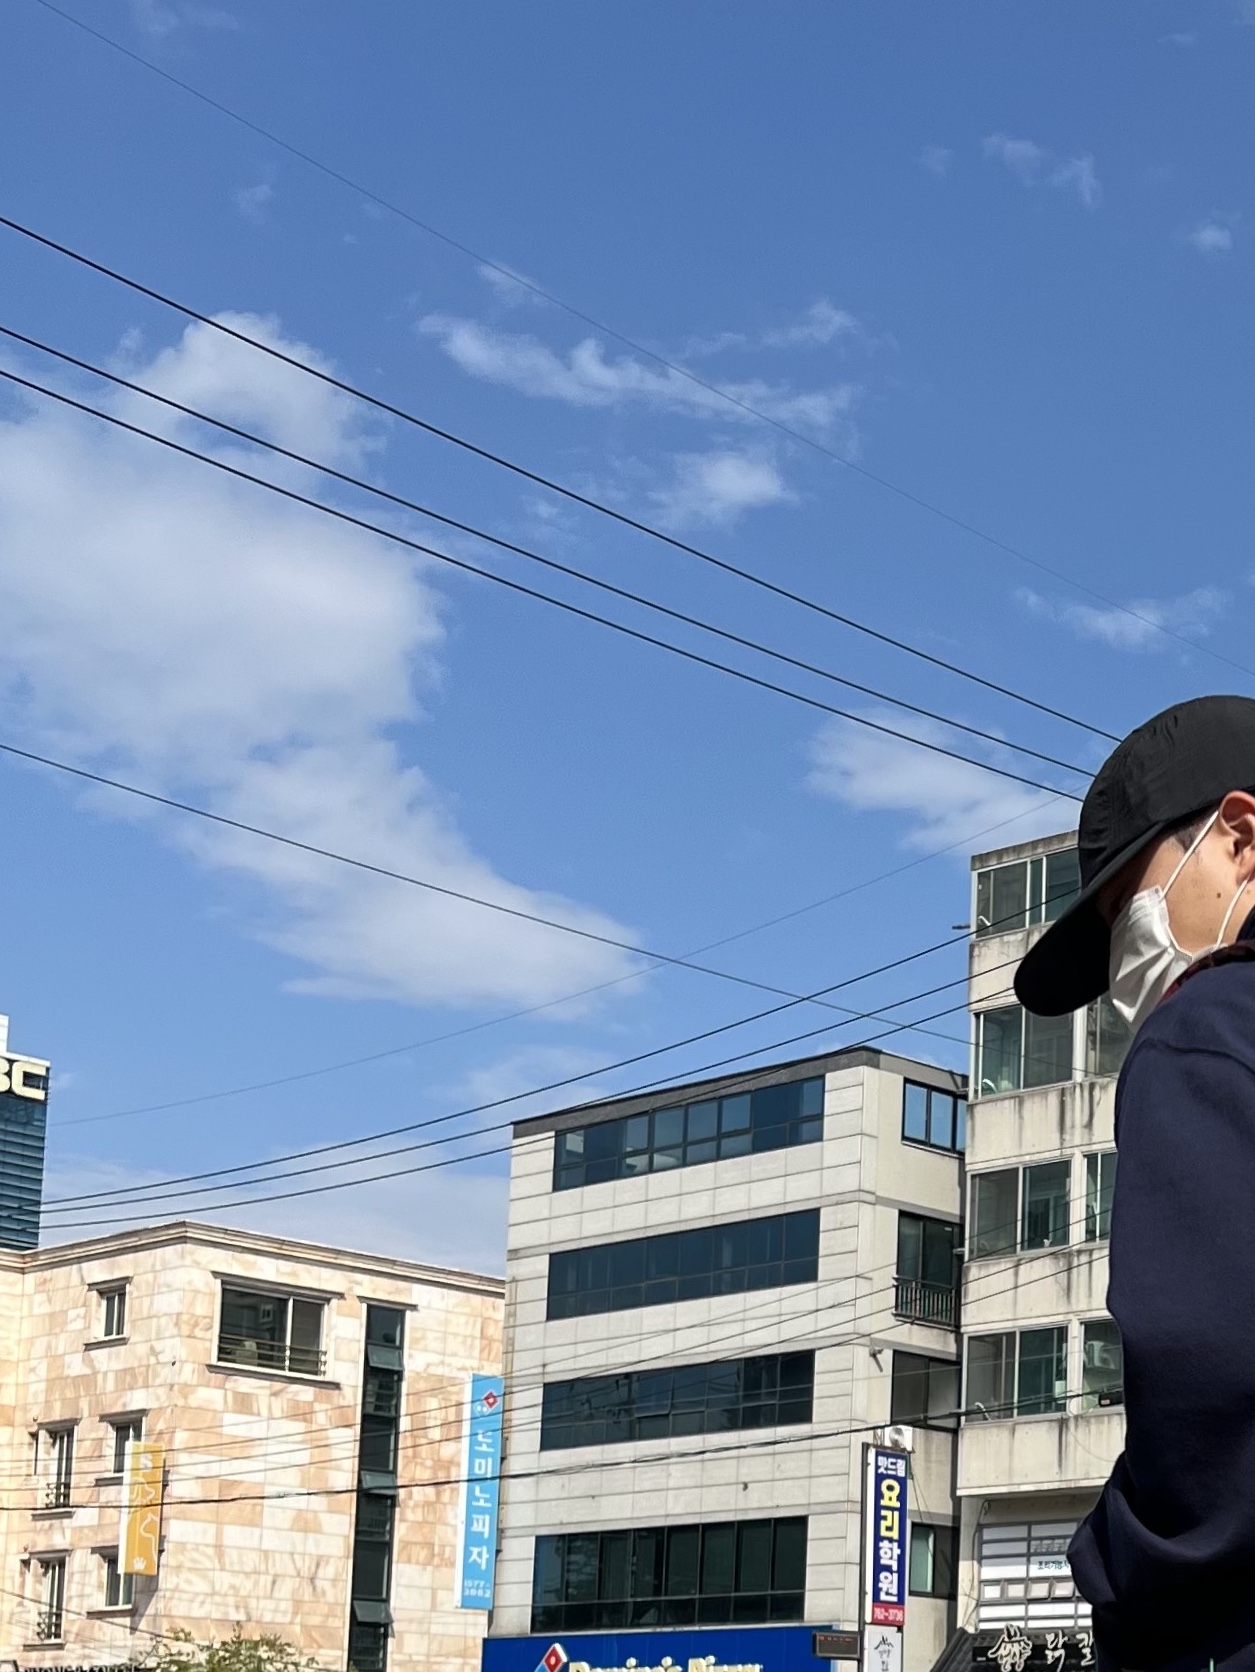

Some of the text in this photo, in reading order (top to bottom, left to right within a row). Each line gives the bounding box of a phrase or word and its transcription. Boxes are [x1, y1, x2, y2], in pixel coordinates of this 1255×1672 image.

[468, 1429, 495, 1571] 도미노피자
[877, 1455, 906, 1477] 맛드림
[878, 1478, 901, 1602] 요리학원
